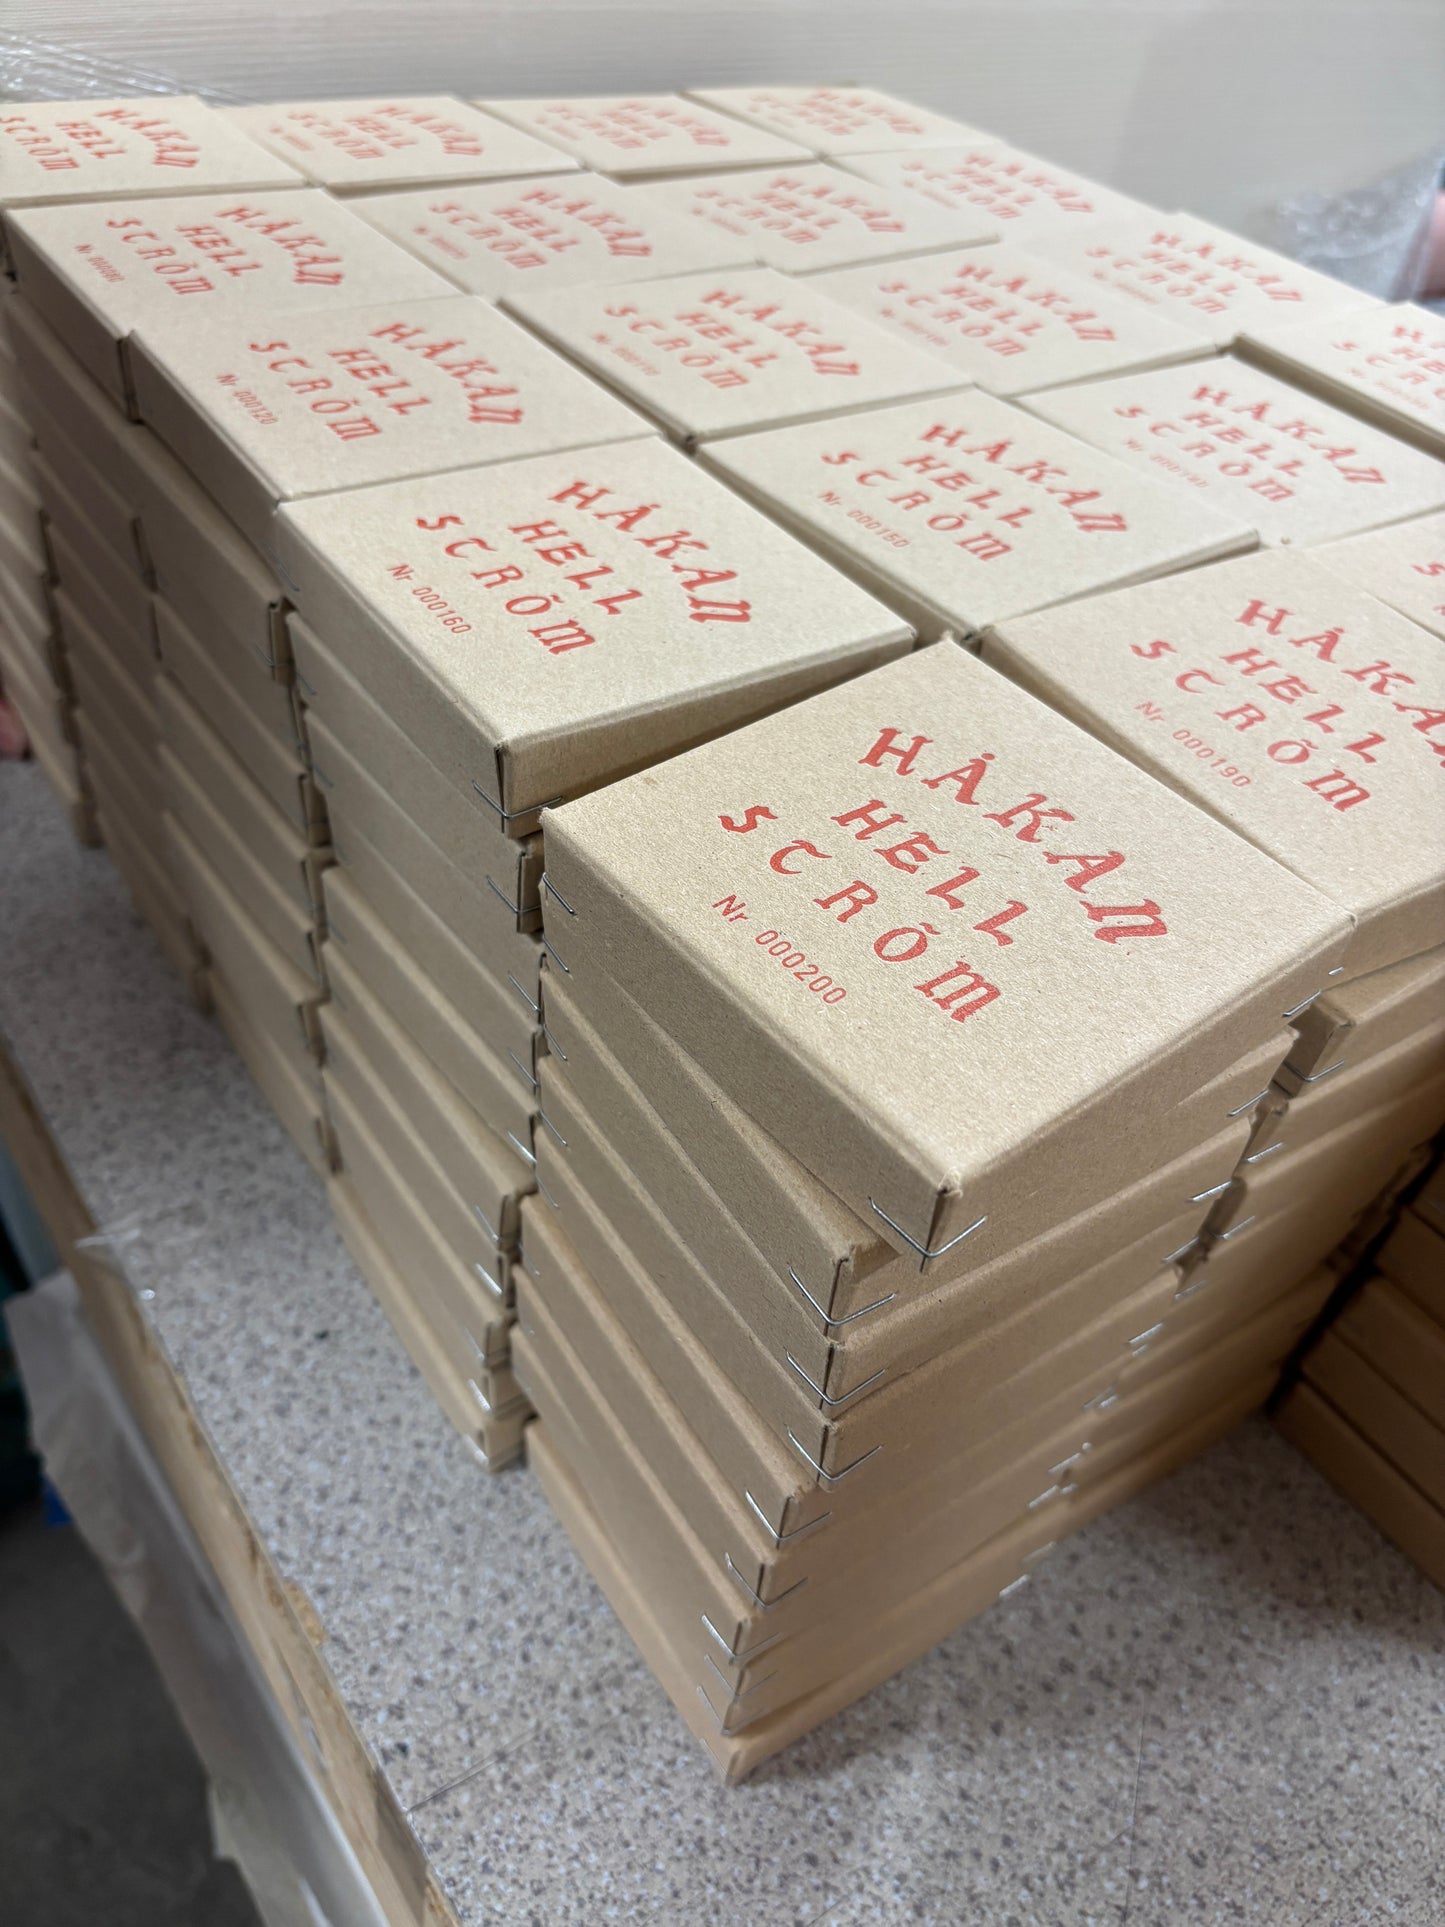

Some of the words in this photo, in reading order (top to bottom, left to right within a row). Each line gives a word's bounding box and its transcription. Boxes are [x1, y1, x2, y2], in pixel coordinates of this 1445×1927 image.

[176, 225, 262, 277] HELL
[216, 373, 239, 386] Nr
[232, 390, 278, 425] 000120
[327, 349, 432, 415] HELL
[1182, 412, 1304, 477] HELL
[818, 491, 842, 506] Nr
[847, 509, 911, 549] 000150
[900, 454, 1035, 529] HELL
[507, 519, 643, 615] HELL
[548, 481, 752, 623] HÅKAN
[387, 563, 413, 581] Nr
[411, 586, 472, 635] 000160
[1134, 701, 1165, 723] Nr
[1172, 729, 1251, 787] 000190
[1219, 647, 1387, 764] HELL
[830, 799, 1029, 947] HELL
[858, 727, 1170, 945] HÅKAN
[712, 894, 749, 922] Nr
[755, 929, 847, 1004] 000200
